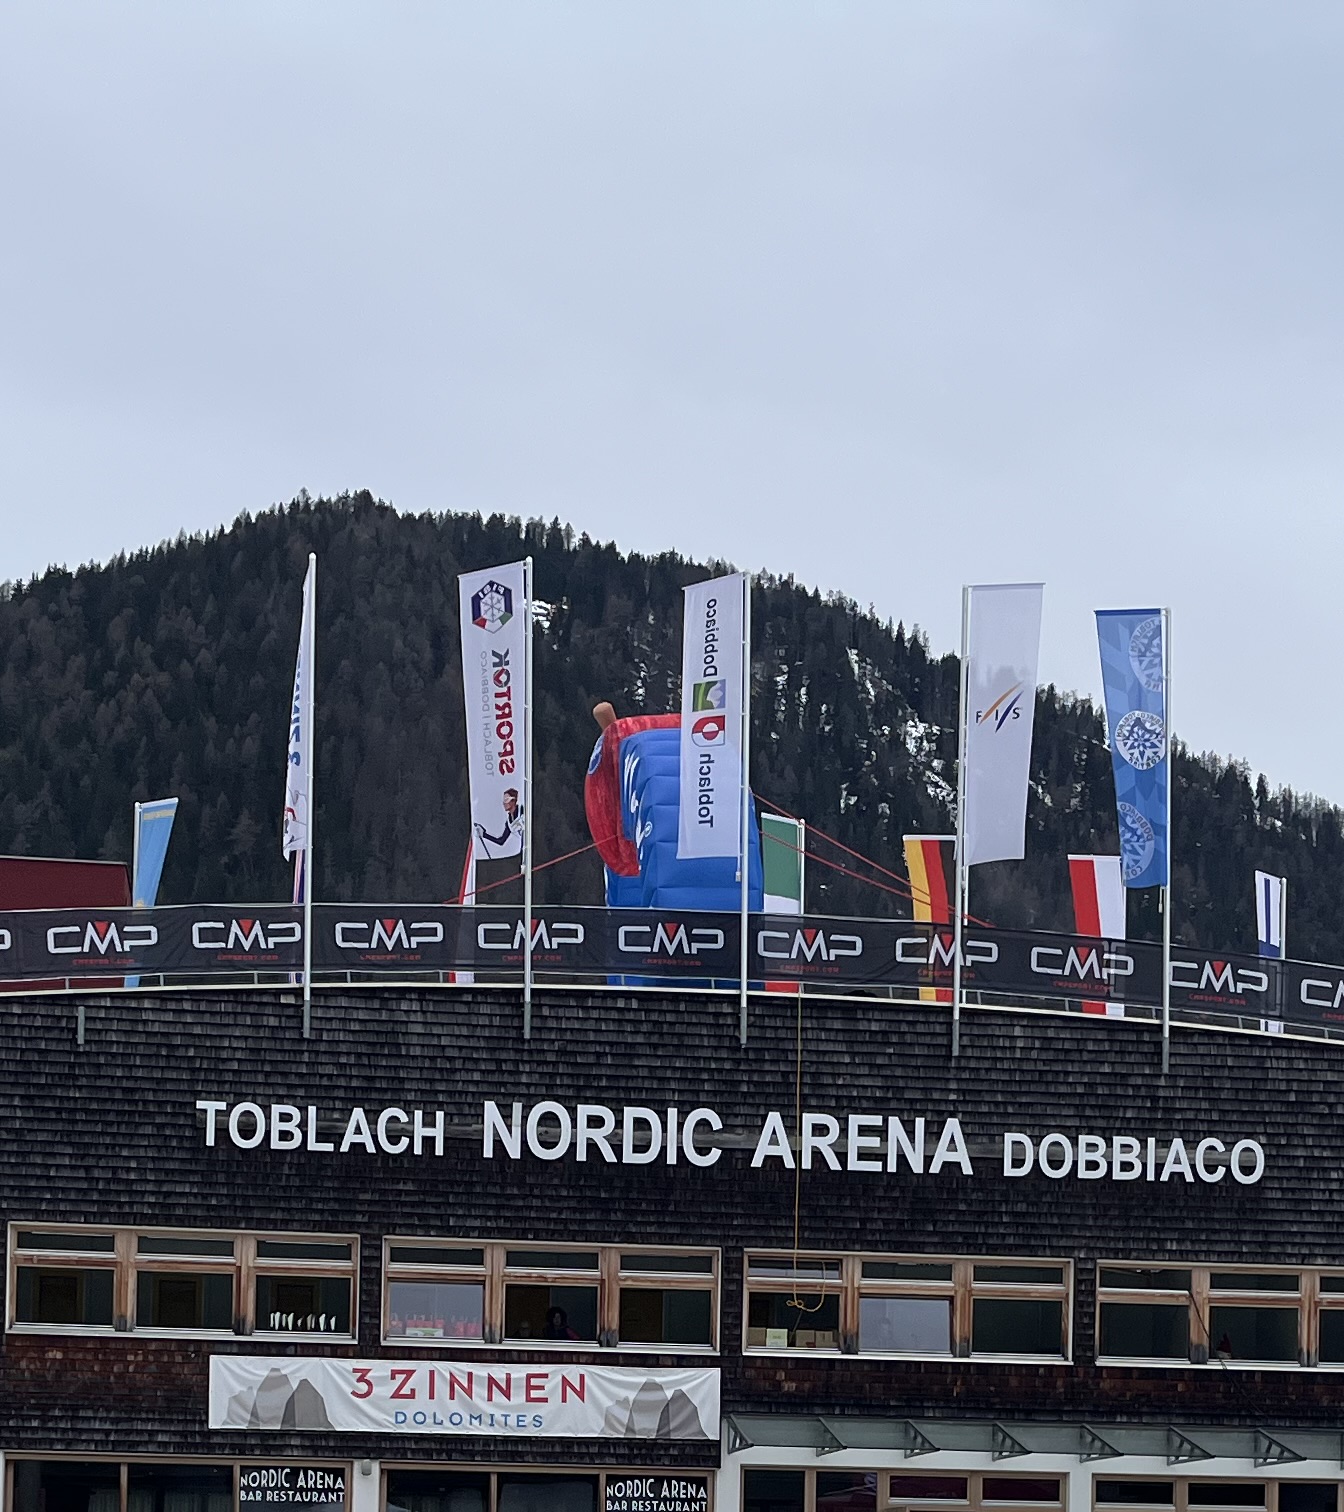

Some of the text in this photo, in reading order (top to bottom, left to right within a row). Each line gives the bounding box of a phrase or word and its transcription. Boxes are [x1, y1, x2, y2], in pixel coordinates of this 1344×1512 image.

[47, 920, 158, 954] CMP
[192, 919, 301, 951] CMP
[335, 919, 444, 951] CMP
[477, 919, 584, 951] CMP
[617, 922, 725, 956] CMP
[757, 929, 863, 962] CMP
[895, 933, 998, 967] CMP
[1030, 946, 1134, 980] CMP
[1169, 960, 1269, 994] CMP
[196, 1101, 1265, 1185] TOBLACH NORDIC ARENA DOBBIACO
[350, 1368, 588, 1404] 3 ZINNEN
[394, 1410, 544, 1429] DOLOMITES
[240, 1468, 345, 1490] NORDIC ARENA
[606, 1479, 708, 1500] NORDIC ARENA
[240, 1489, 345, 1504] BAR RESTAURANT
[606, 1500, 708, 1512] BAR RESTAURANT
